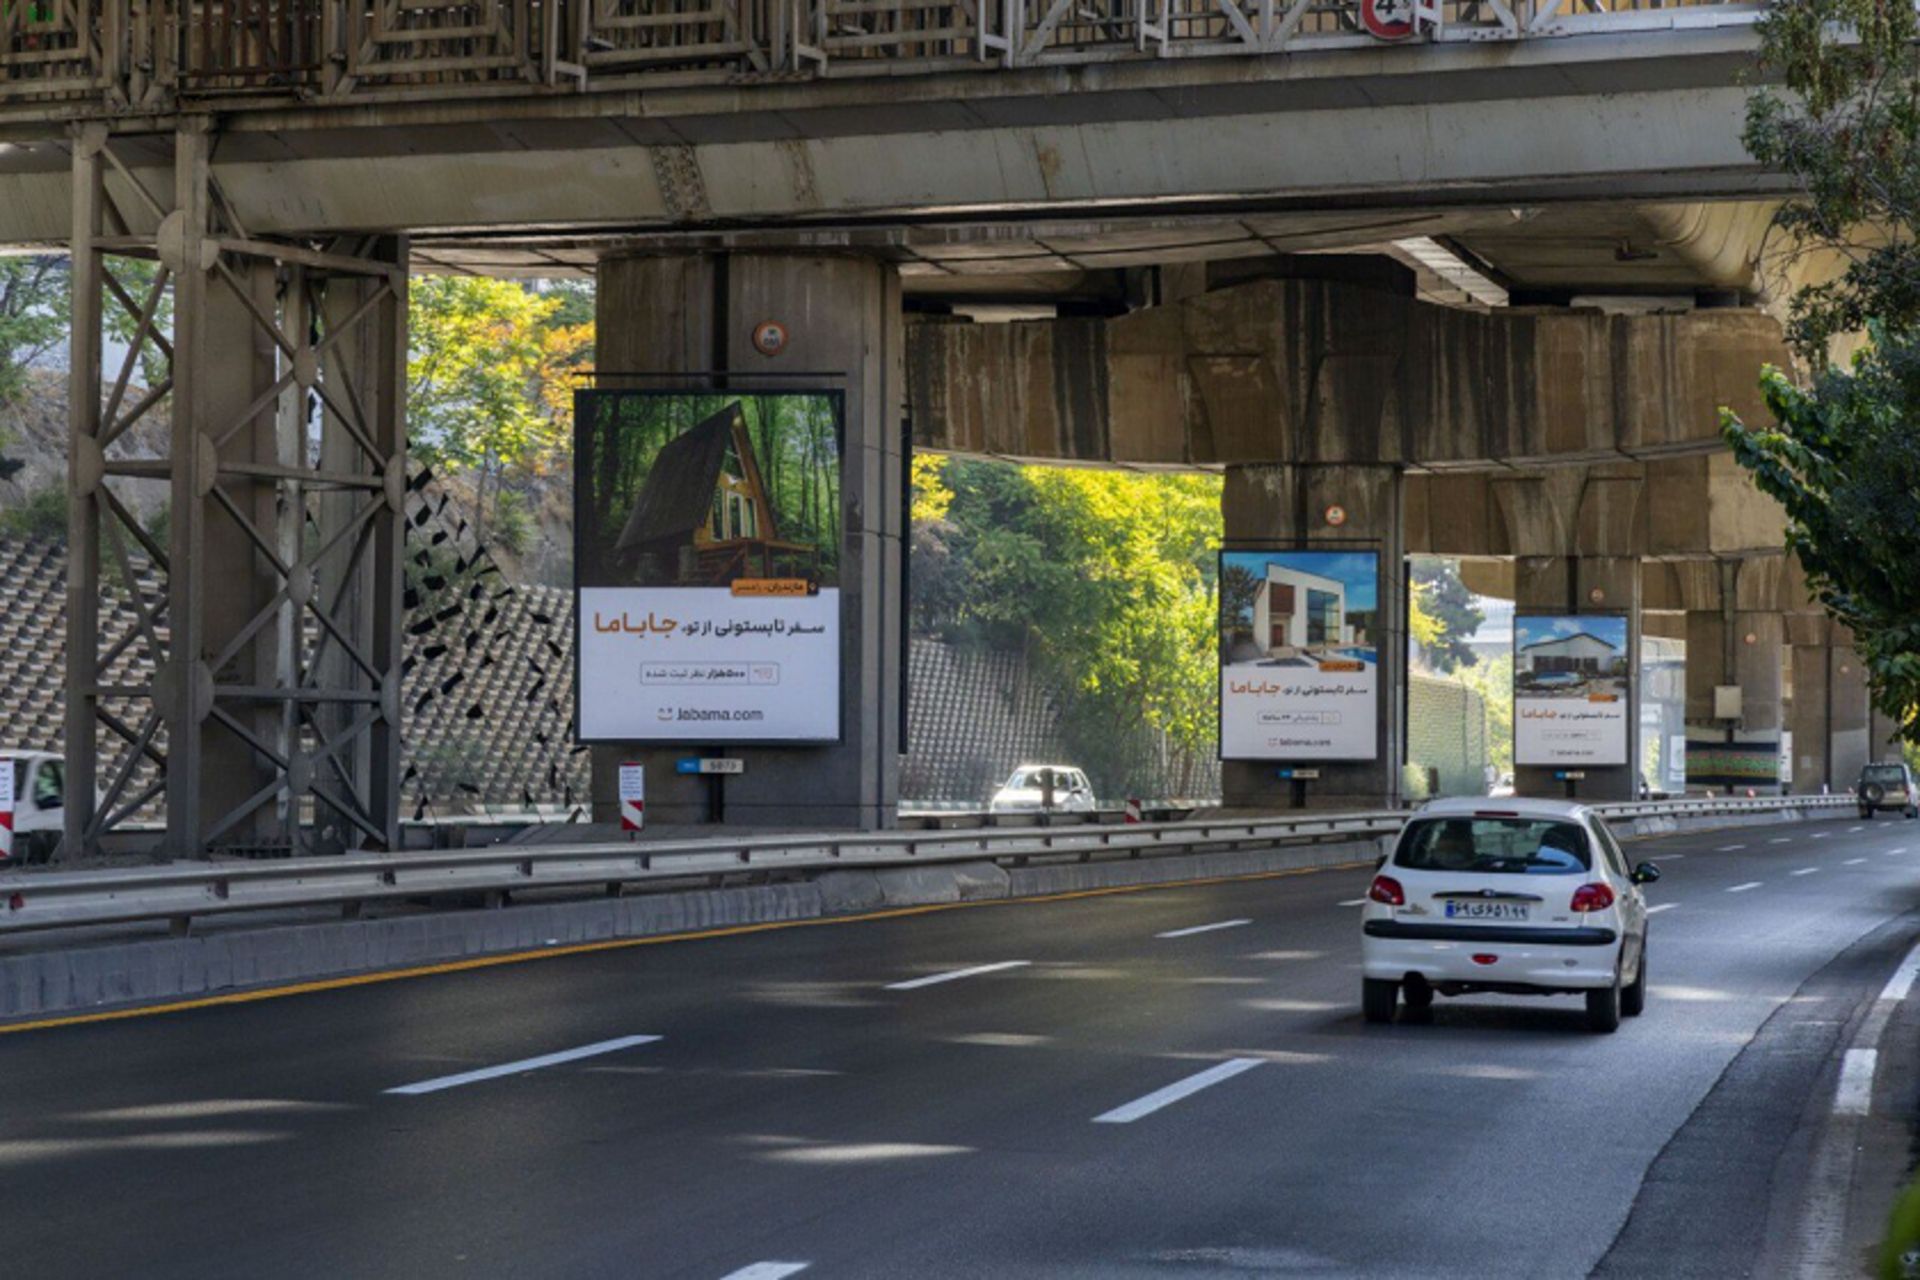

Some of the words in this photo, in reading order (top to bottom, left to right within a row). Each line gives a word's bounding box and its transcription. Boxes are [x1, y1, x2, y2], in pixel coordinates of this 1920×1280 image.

[594, 611, 678, 639] جاباما
[701, 620, 711, 636] از
[715, 618, 785, 638] تابستونی
[788, 622, 826, 636] سفر
[1230, 680, 1280, 698] جاباما
[677, 707, 764, 721] Jabama.com
